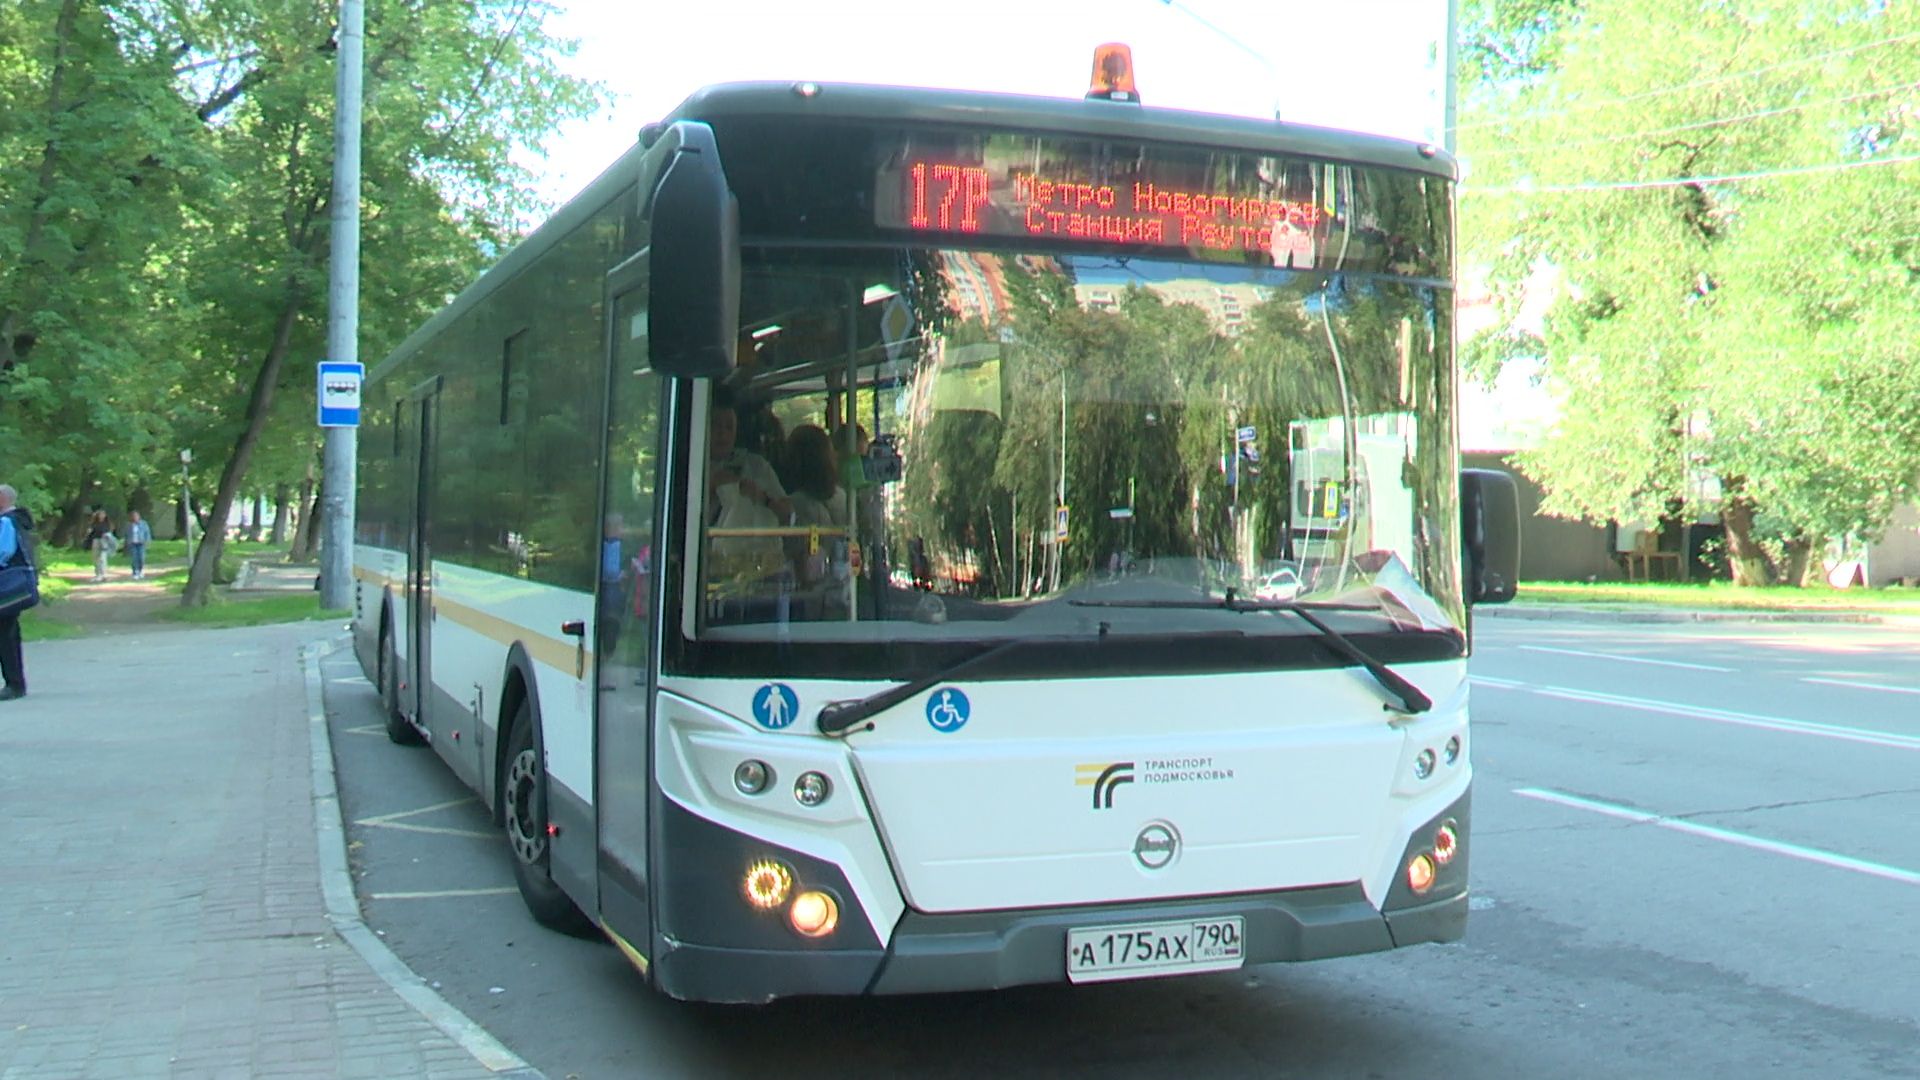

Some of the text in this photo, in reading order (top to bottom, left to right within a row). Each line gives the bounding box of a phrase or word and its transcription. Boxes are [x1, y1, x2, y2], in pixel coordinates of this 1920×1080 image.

[911, 163, 988, 232] 17Р
[1016, 172, 1115, 210] Метро
[1026, 203, 1312, 251] Станция Реуто
[1144, 758, 1213, 770] ТРАНСПОРТ
[1144, 770, 1234, 783] ПОДМОСКОВЬЯ
[1195, 923, 1235, 948] 790
[1203, 947, 1225, 957] RUS
